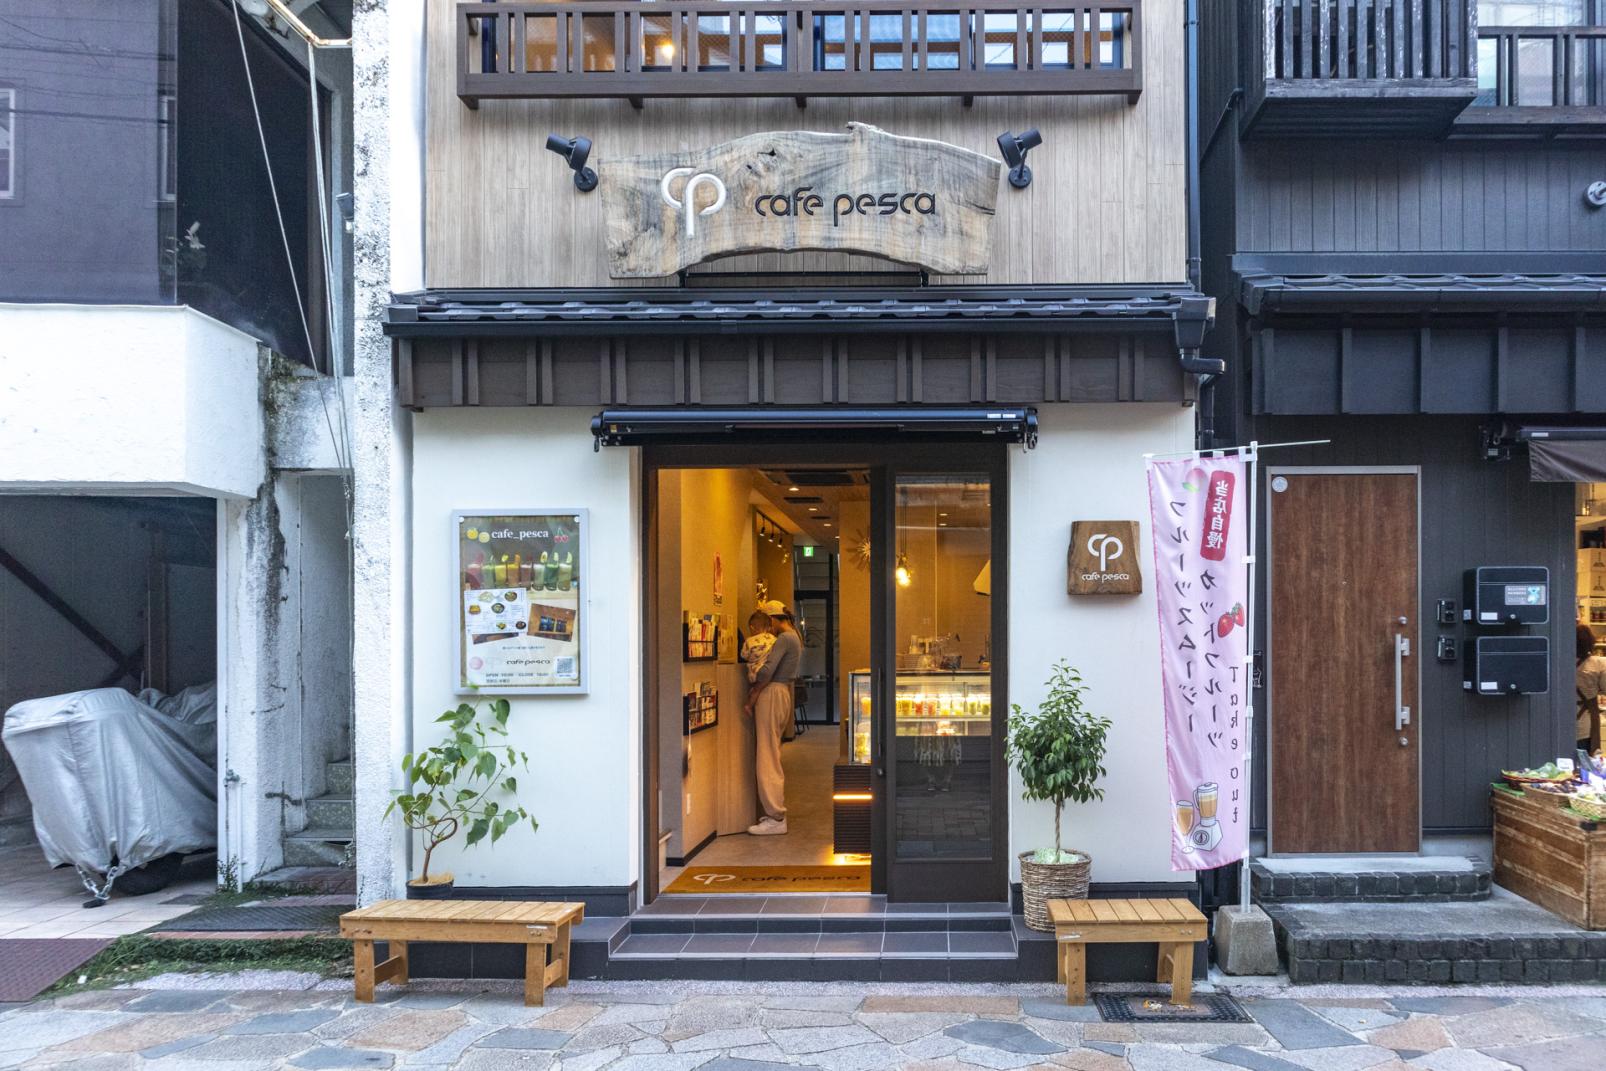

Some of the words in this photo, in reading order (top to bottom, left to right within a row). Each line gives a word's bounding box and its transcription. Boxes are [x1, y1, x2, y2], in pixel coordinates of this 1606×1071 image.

[754, 186, 824, 217] cafe
[833, 192, 936, 228] pesca
[491, 528, 549, 540] cafe_pesca
[1081, 571, 1100, 581] cafe
[1101, 573, 1130, 583] pesca
